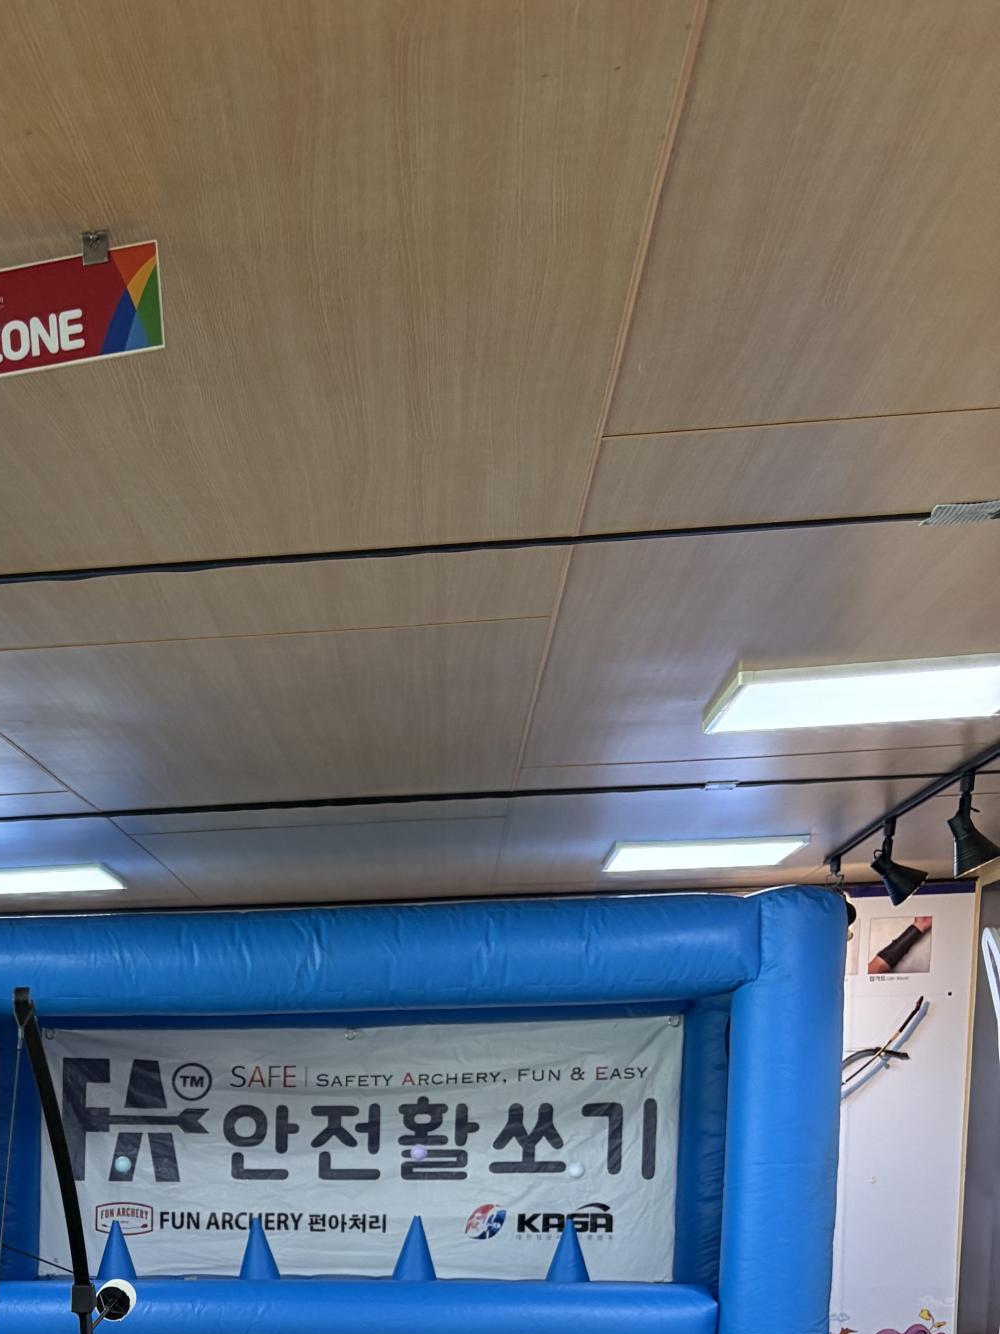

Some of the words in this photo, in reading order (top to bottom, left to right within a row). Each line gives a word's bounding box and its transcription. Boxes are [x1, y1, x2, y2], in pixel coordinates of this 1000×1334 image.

[179, 1075, 205, 1088] TM
[230, 1065, 297, 1088] SAFE
[316, 1073, 393, 1088] SAFETY
[401, 1070, 508, 1087] ARCHERY,
[517, 1068, 561, 1082] FUN
[570, 1067, 586, 1082] &
[595, 1065, 648, 1082] EASY
[222, 1096, 658, 1181] 안전활쏘기
[100, 1208, 115, 1219] FUN
[116, 1207, 149, 1220] ARCHERY
[159, 1211, 200, 1230] FUN
[307, 1213, 388, 1234] 편아처리
[517, 1212, 613, 1233] KASA
